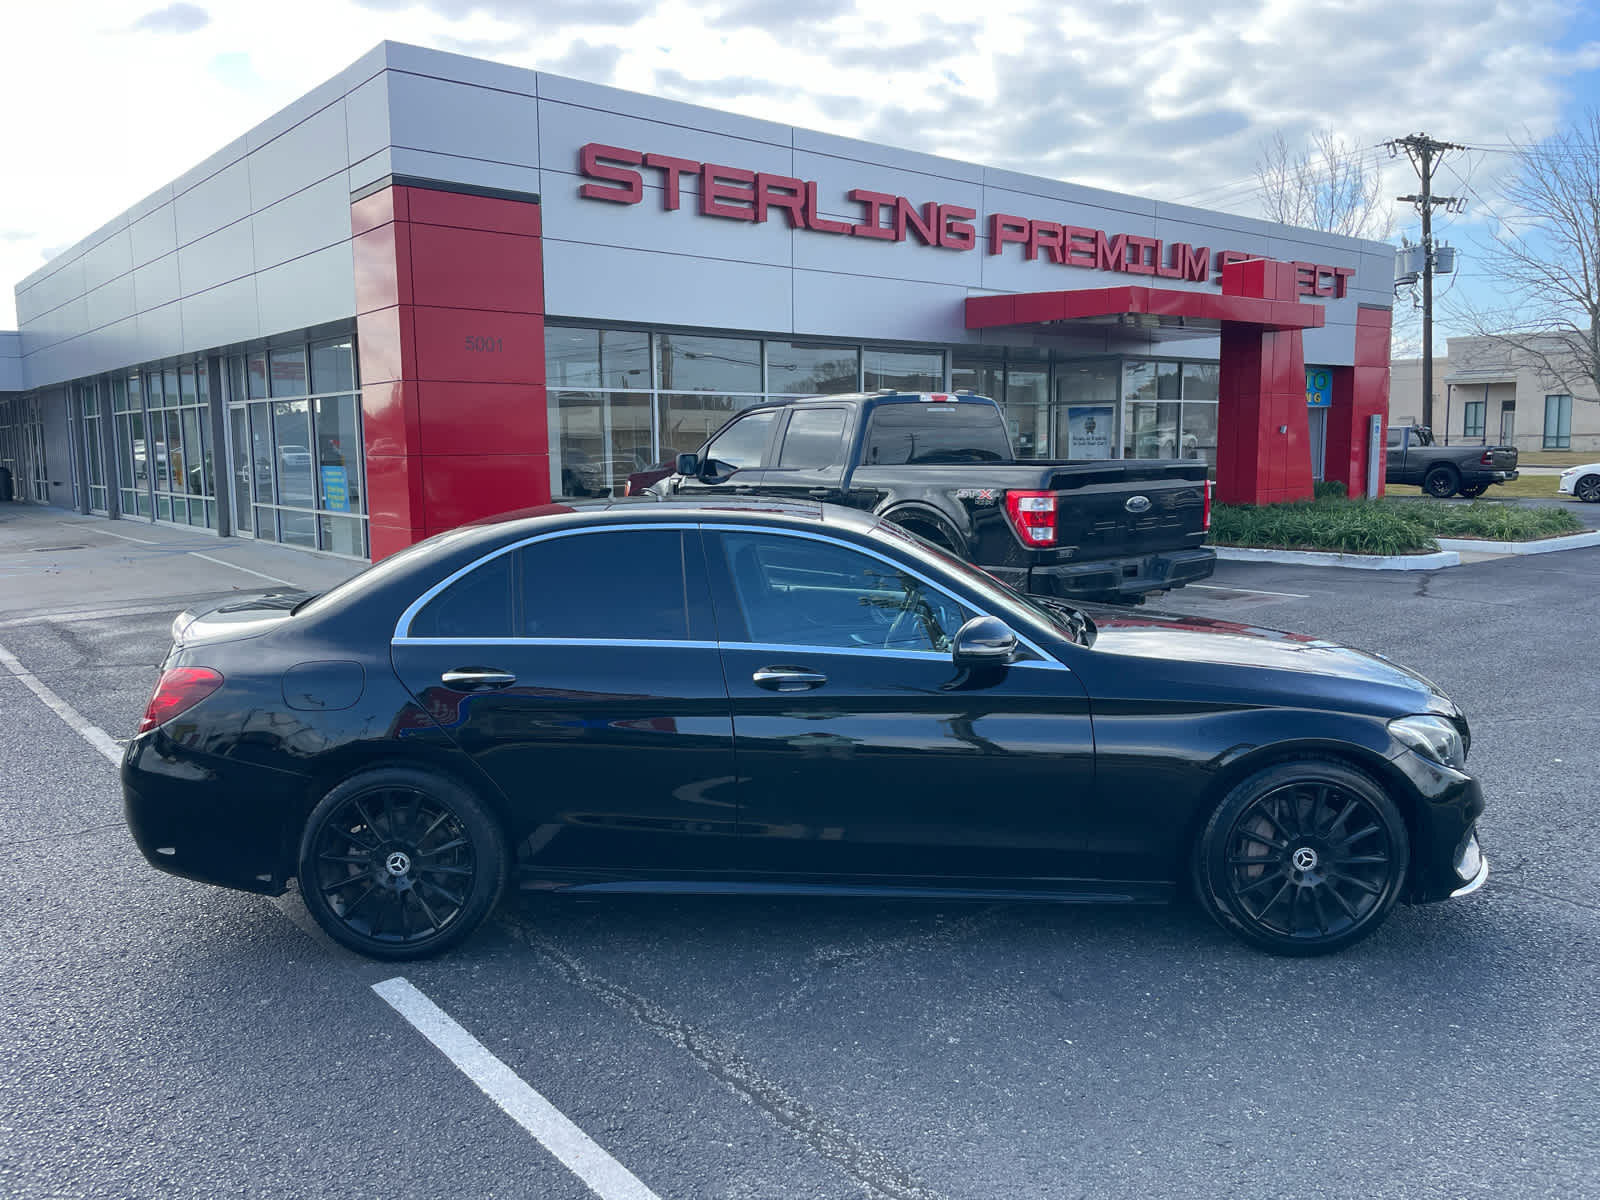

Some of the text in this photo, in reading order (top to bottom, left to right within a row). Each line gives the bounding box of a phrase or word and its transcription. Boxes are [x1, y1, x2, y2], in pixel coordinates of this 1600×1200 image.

[580, 142, 1356, 299] STERLING PREMIUM SECT
[464, 335, 504, 353] 5001
